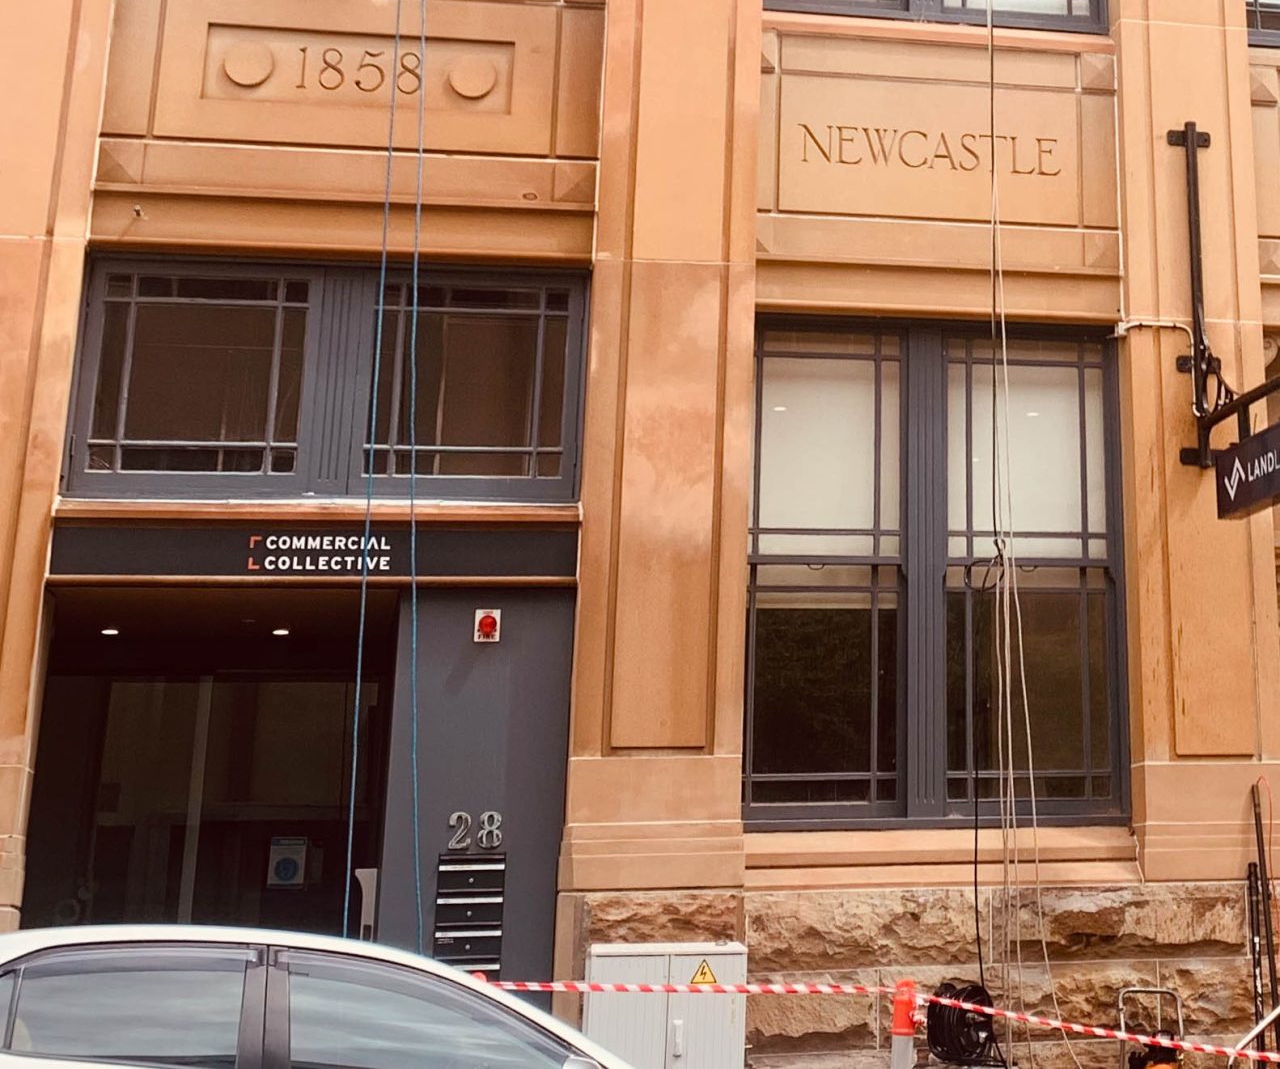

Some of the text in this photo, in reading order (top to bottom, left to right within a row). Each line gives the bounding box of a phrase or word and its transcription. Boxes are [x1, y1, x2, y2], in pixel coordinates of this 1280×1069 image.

[295, 46, 423, 95] 1858
[797, 123, 1062, 177] NEWCASTLE
[265, 535, 392, 550] COMMERCIAL
[263, 556, 391, 571] COLLECTIVE
[448, 811, 503, 850] 28
